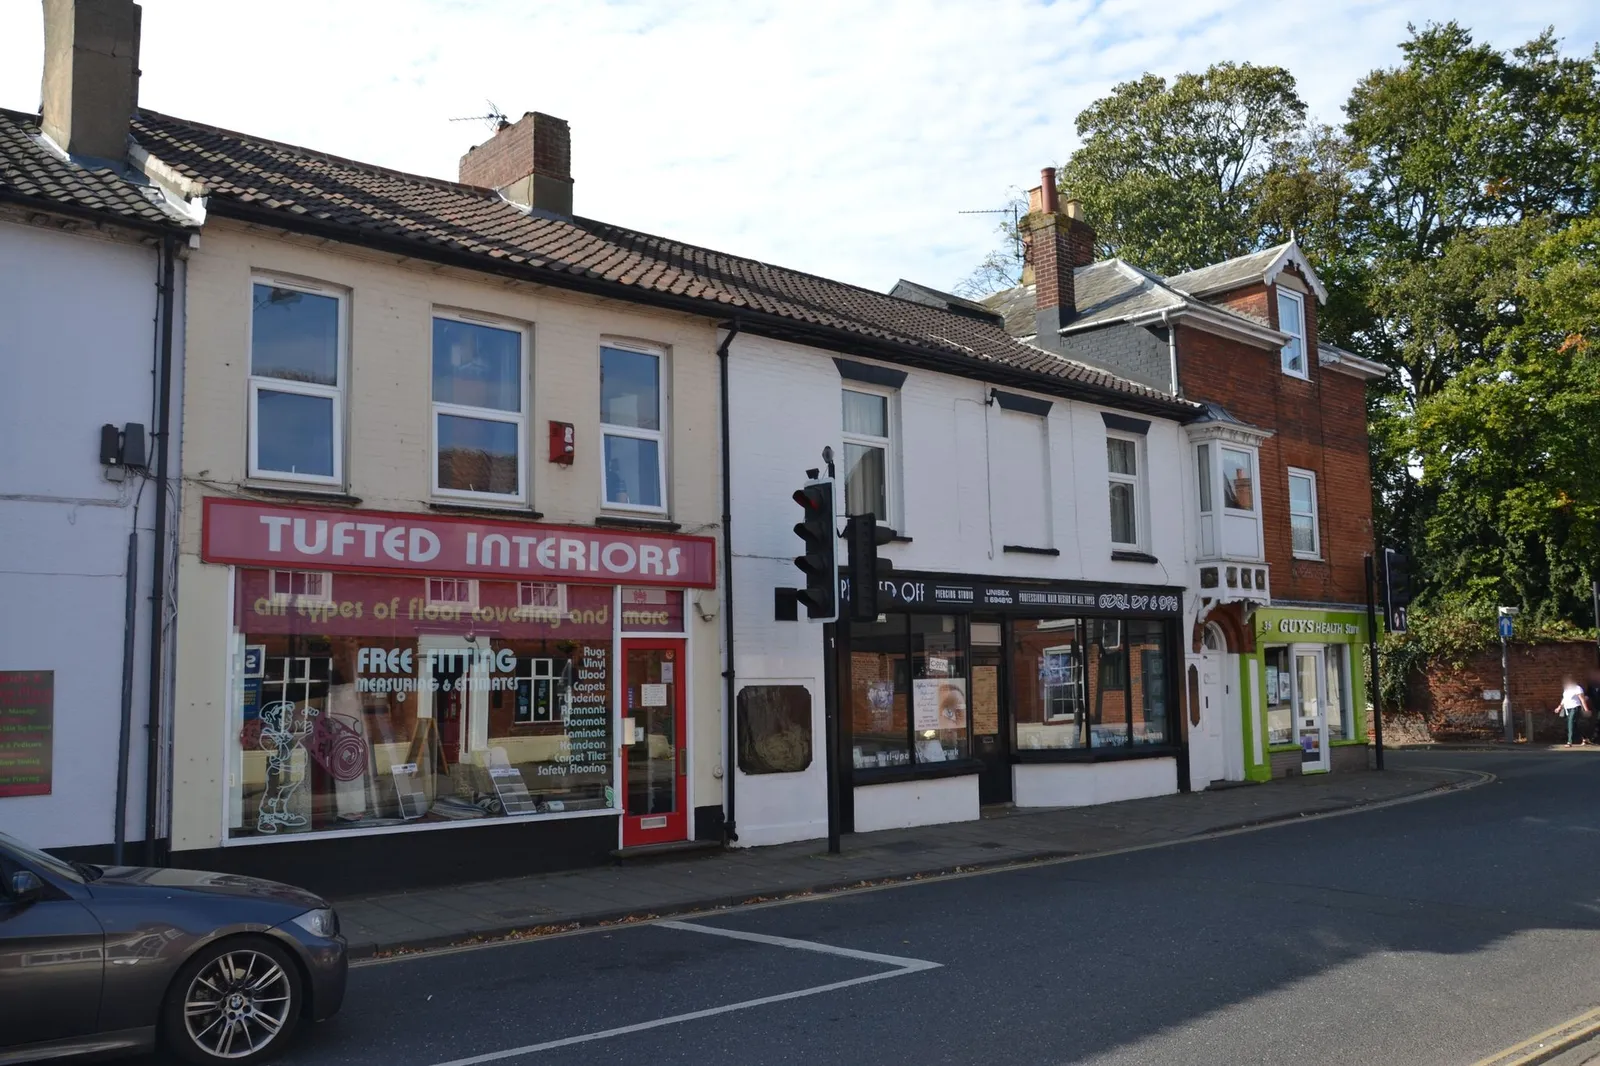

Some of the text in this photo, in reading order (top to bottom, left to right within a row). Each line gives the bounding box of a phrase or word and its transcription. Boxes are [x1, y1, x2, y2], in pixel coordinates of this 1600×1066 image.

[260, 515, 681, 576] TUFTED INTERIORS
[901, 582, 925, 603] OFF
[935, 588, 974, 600] PIERCING STUDIO
[985, 588, 1010, 597] UNISEX
[1019, 592, 1047, 603] PROFESSIONAL
[1048, 594, 1057, 604] HAIR
[1058, 594, 1071, 605] DESIGN
[1072, 595, 1077, 605] OF
[1084, 595, 1096, 606] TYPES
[1099, 594, 1130, 611] CURL
[1131, 595, 1149, 610] UP
[254, 595, 669, 629] all types of floor covering and more
[1280, 619, 1315, 633] GUYS
[1316, 622, 1342, 634] HEALTH
[583, 646, 606, 659] Rugs
[357, 648, 517, 673] FREE FITTING
[583, 658, 606, 670] Vinyl
[930, 660, 948, 669] OPEN
[578, 670, 606, 680] Wood
[355, 677, 519, 692] MEASURING & ESTIMATES
[573, 681, 606, 694] Carpets
[564, 692, 606, 705] Underlay
[560, 705, 606, 716] Remnants
[563, 717, 606, 727] Doormats
[564, 728, 606, 739] Laminate
[560, 739, 606, 751] Karndean
[554, 750, 606, 765] Carpet Tiles
[537, 763, 607, 777] Safety Flooring
